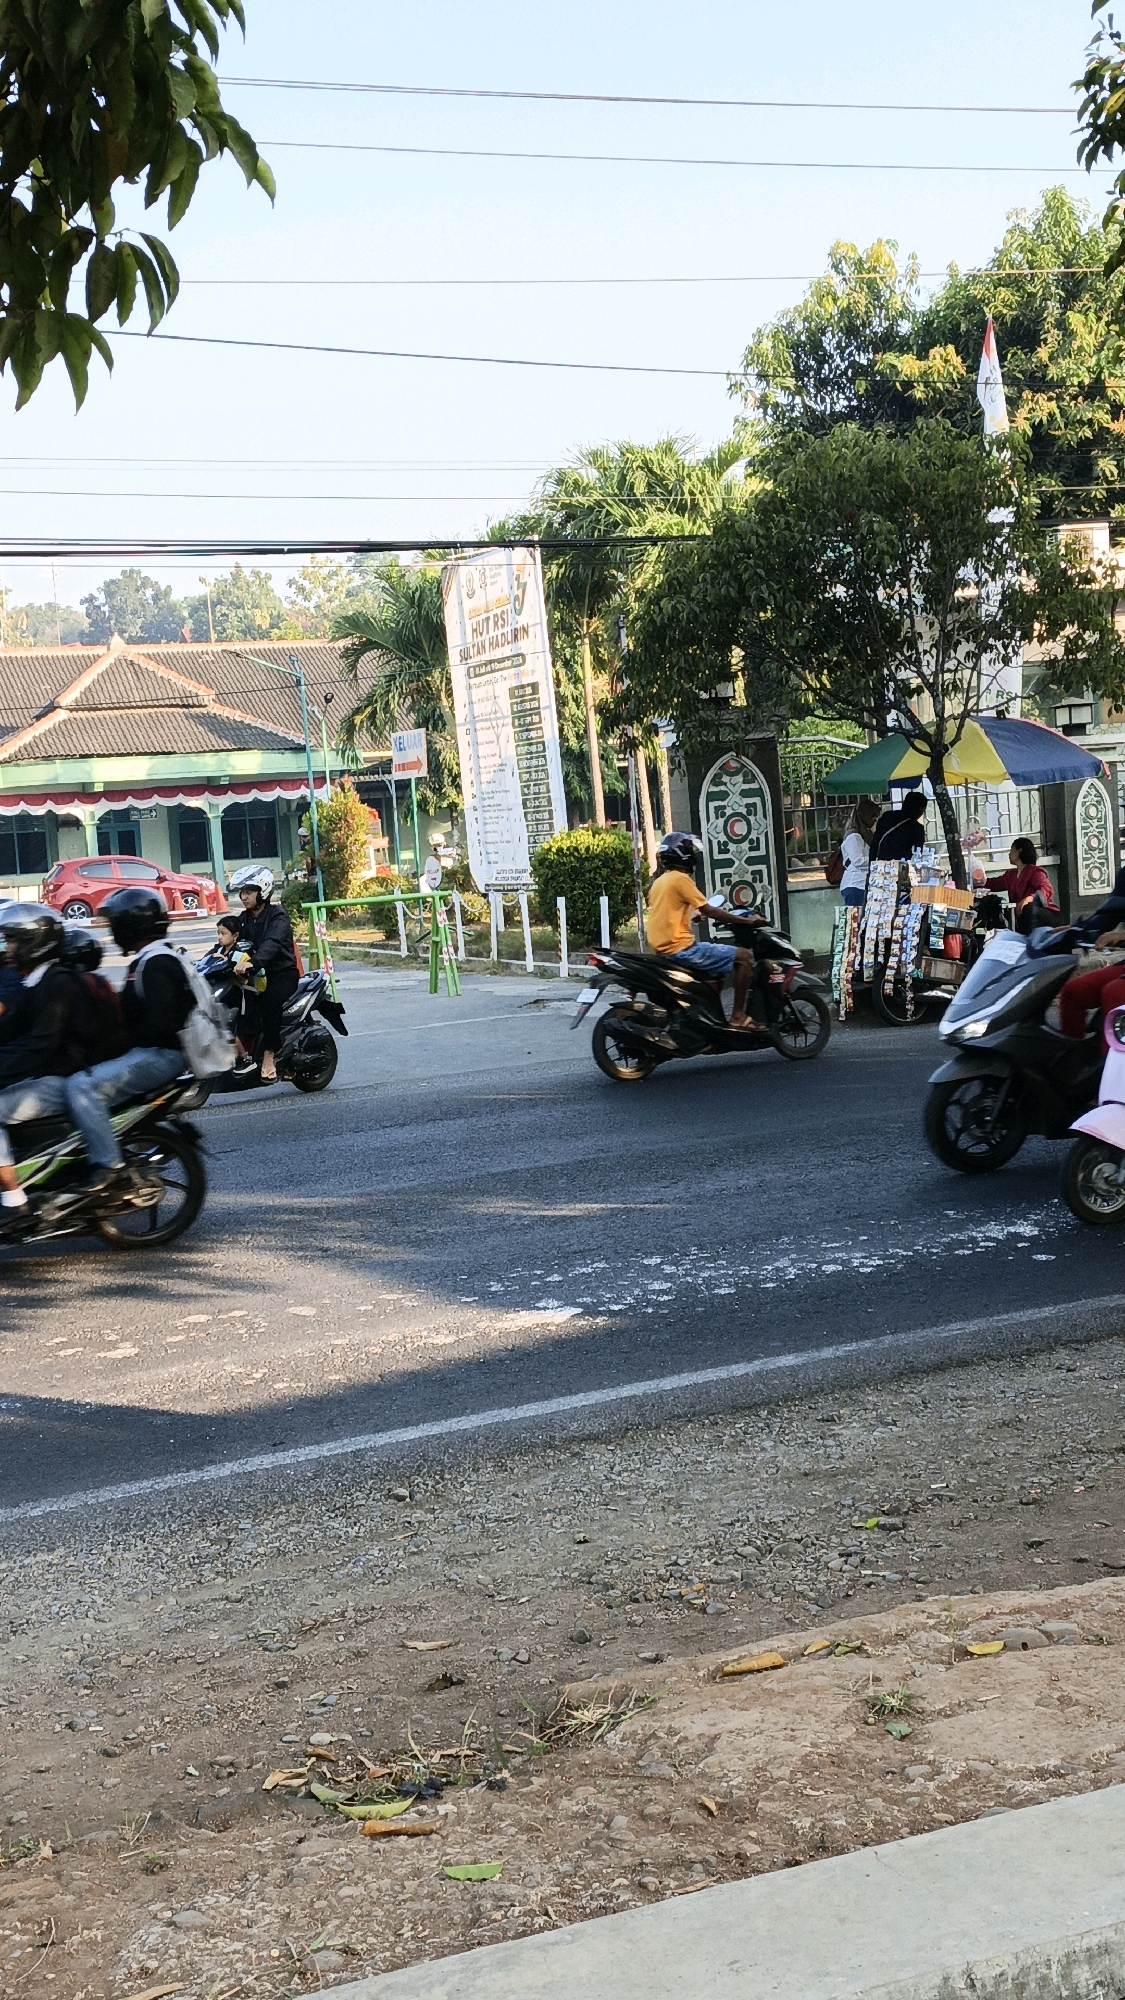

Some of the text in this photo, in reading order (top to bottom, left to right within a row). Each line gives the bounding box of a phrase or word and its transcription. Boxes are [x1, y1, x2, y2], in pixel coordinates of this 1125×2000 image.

[471, 609, 509, 642] HUT RSI
[459, 623, 529, 663] SULTAN HADLIRIN
[393, 732, 422, 752] KELUAR
